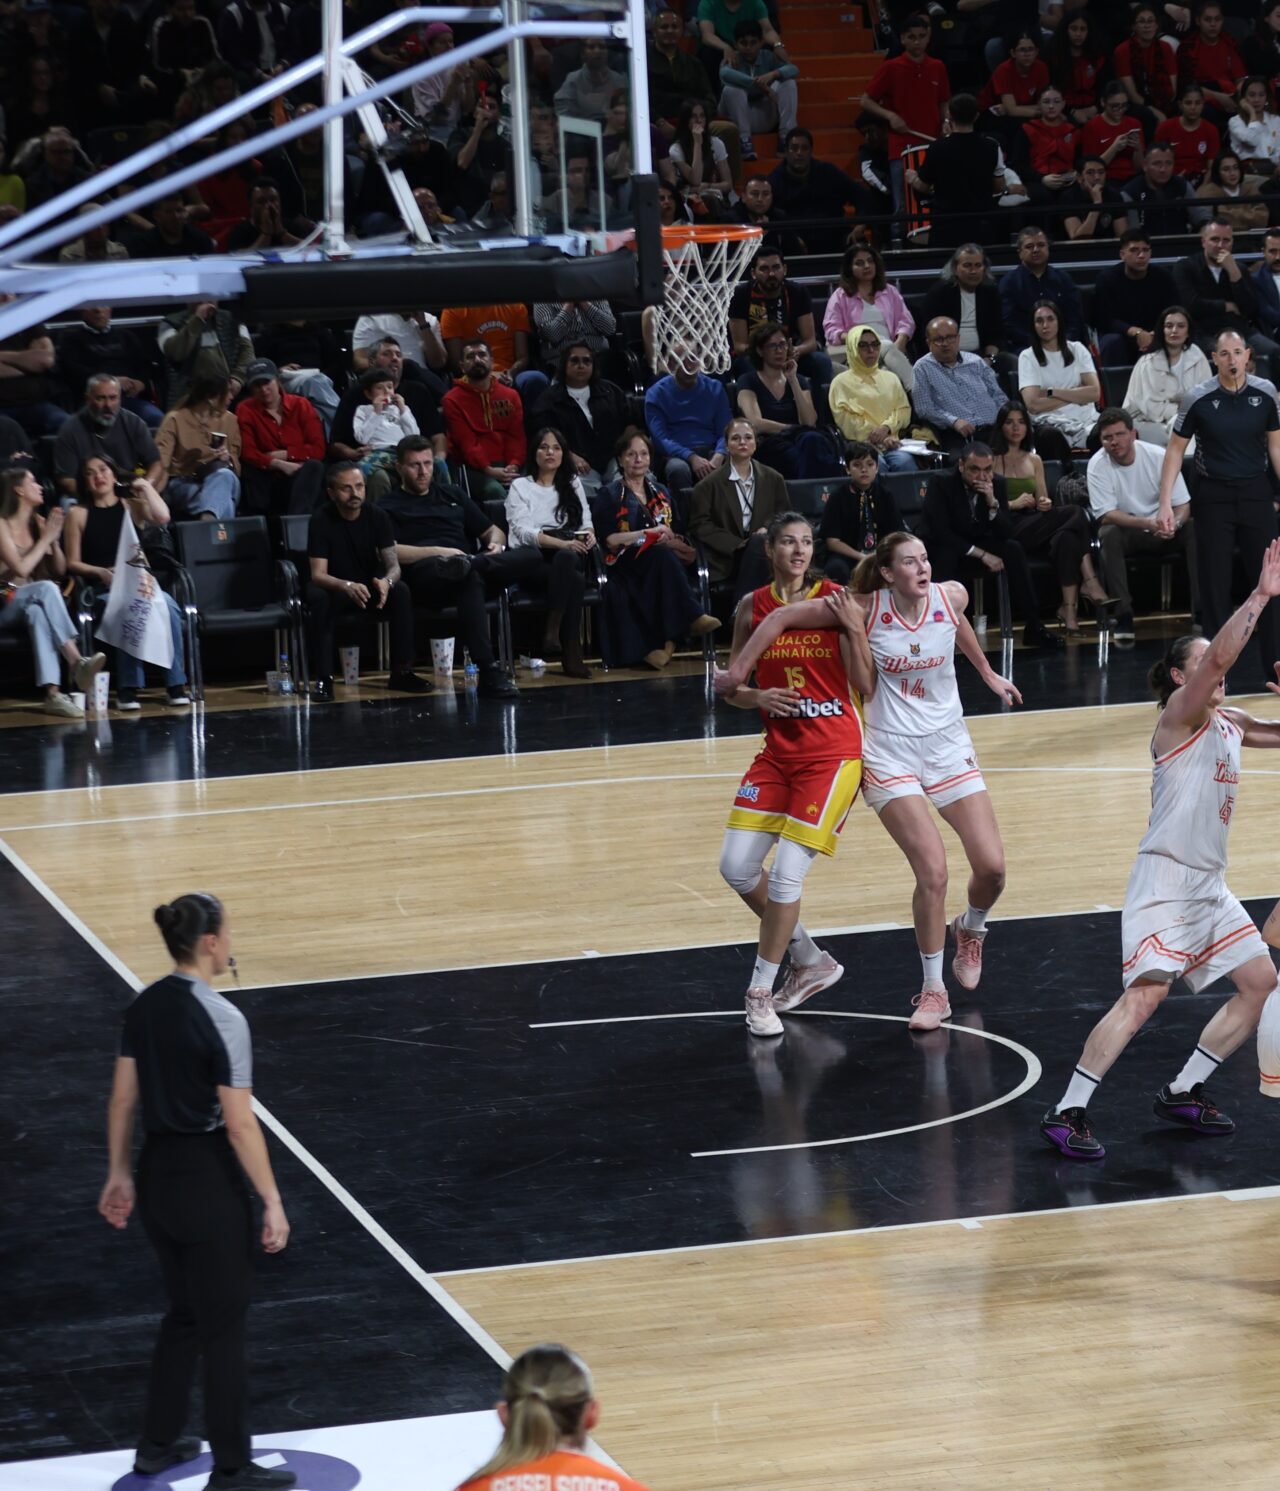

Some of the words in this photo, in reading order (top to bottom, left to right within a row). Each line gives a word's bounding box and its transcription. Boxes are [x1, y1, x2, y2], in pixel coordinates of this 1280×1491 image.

[771, 634, 821, 646] UALCO
[761, 645, 832, 660] ΘΗΝΑΪΚΟΣ
[883, 656, 945, 673] Mersin
[784, 666, 806, 688] 15
[901, 679, 926, 699] 14
[771, 698, 843, 718] ibet
